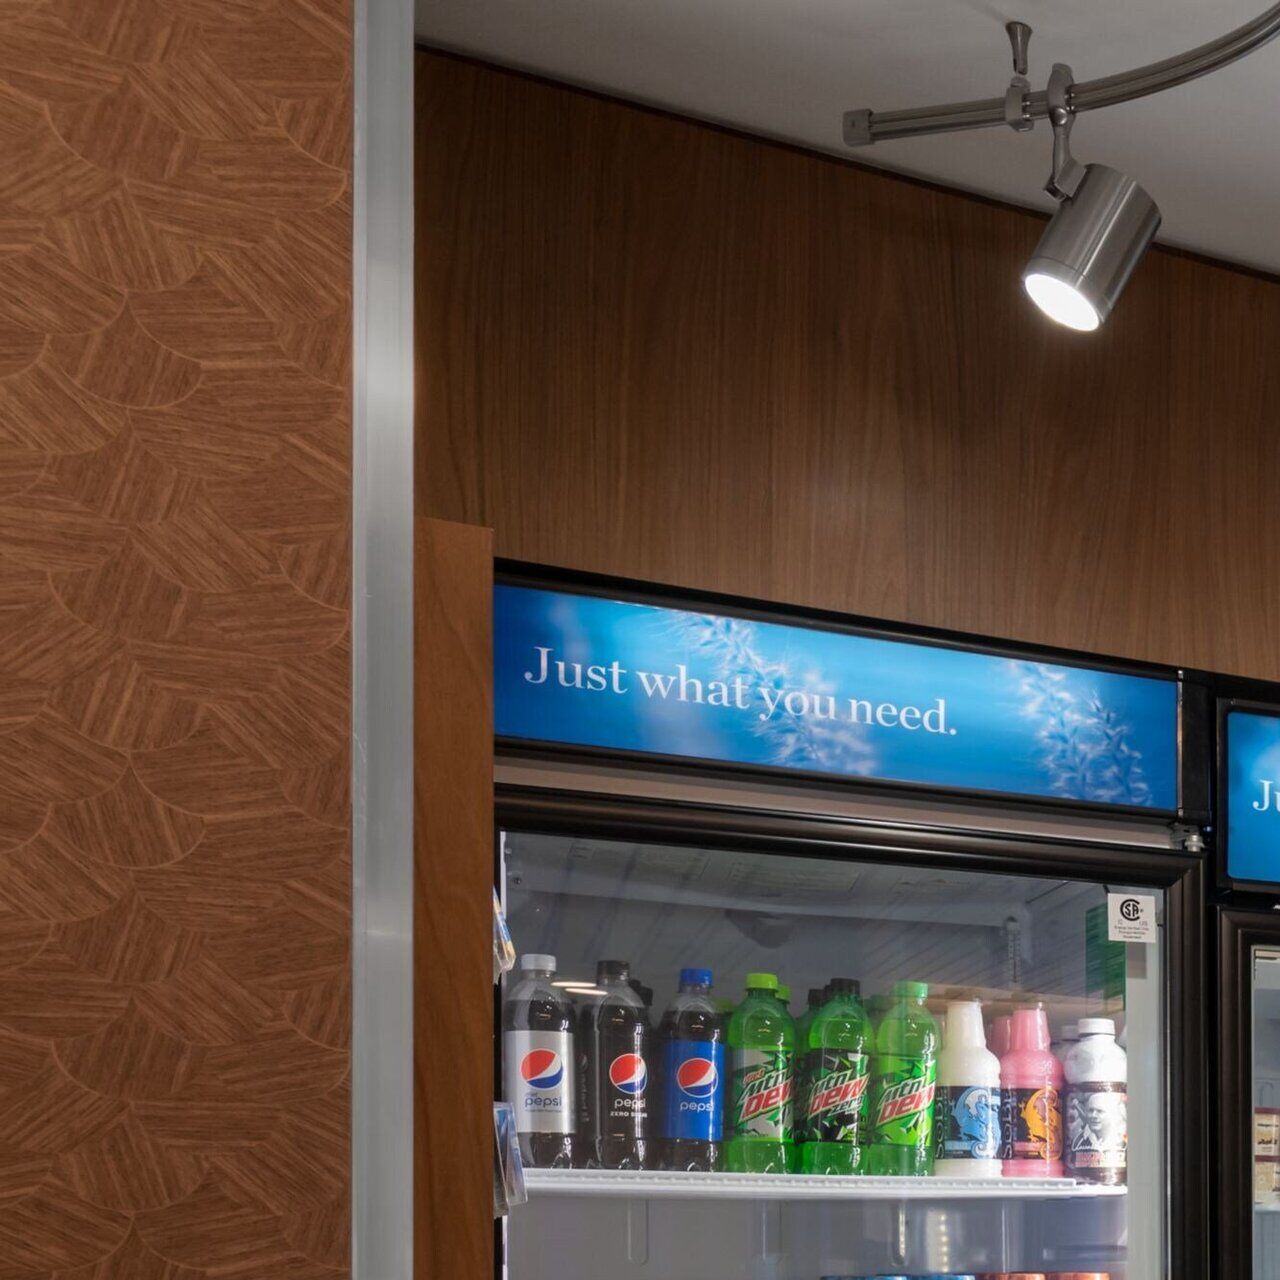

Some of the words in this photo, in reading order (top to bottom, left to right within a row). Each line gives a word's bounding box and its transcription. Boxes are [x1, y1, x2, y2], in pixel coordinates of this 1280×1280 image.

[525, 646, 627, 694] Just
[638, 665, 751, 711] what
[758, 687, 839, 723] you
[848, 700, 958, 737] need.
[525, 1095, 562, 1107] pepsi
[614, 1098, 647, 1109] pepsi
